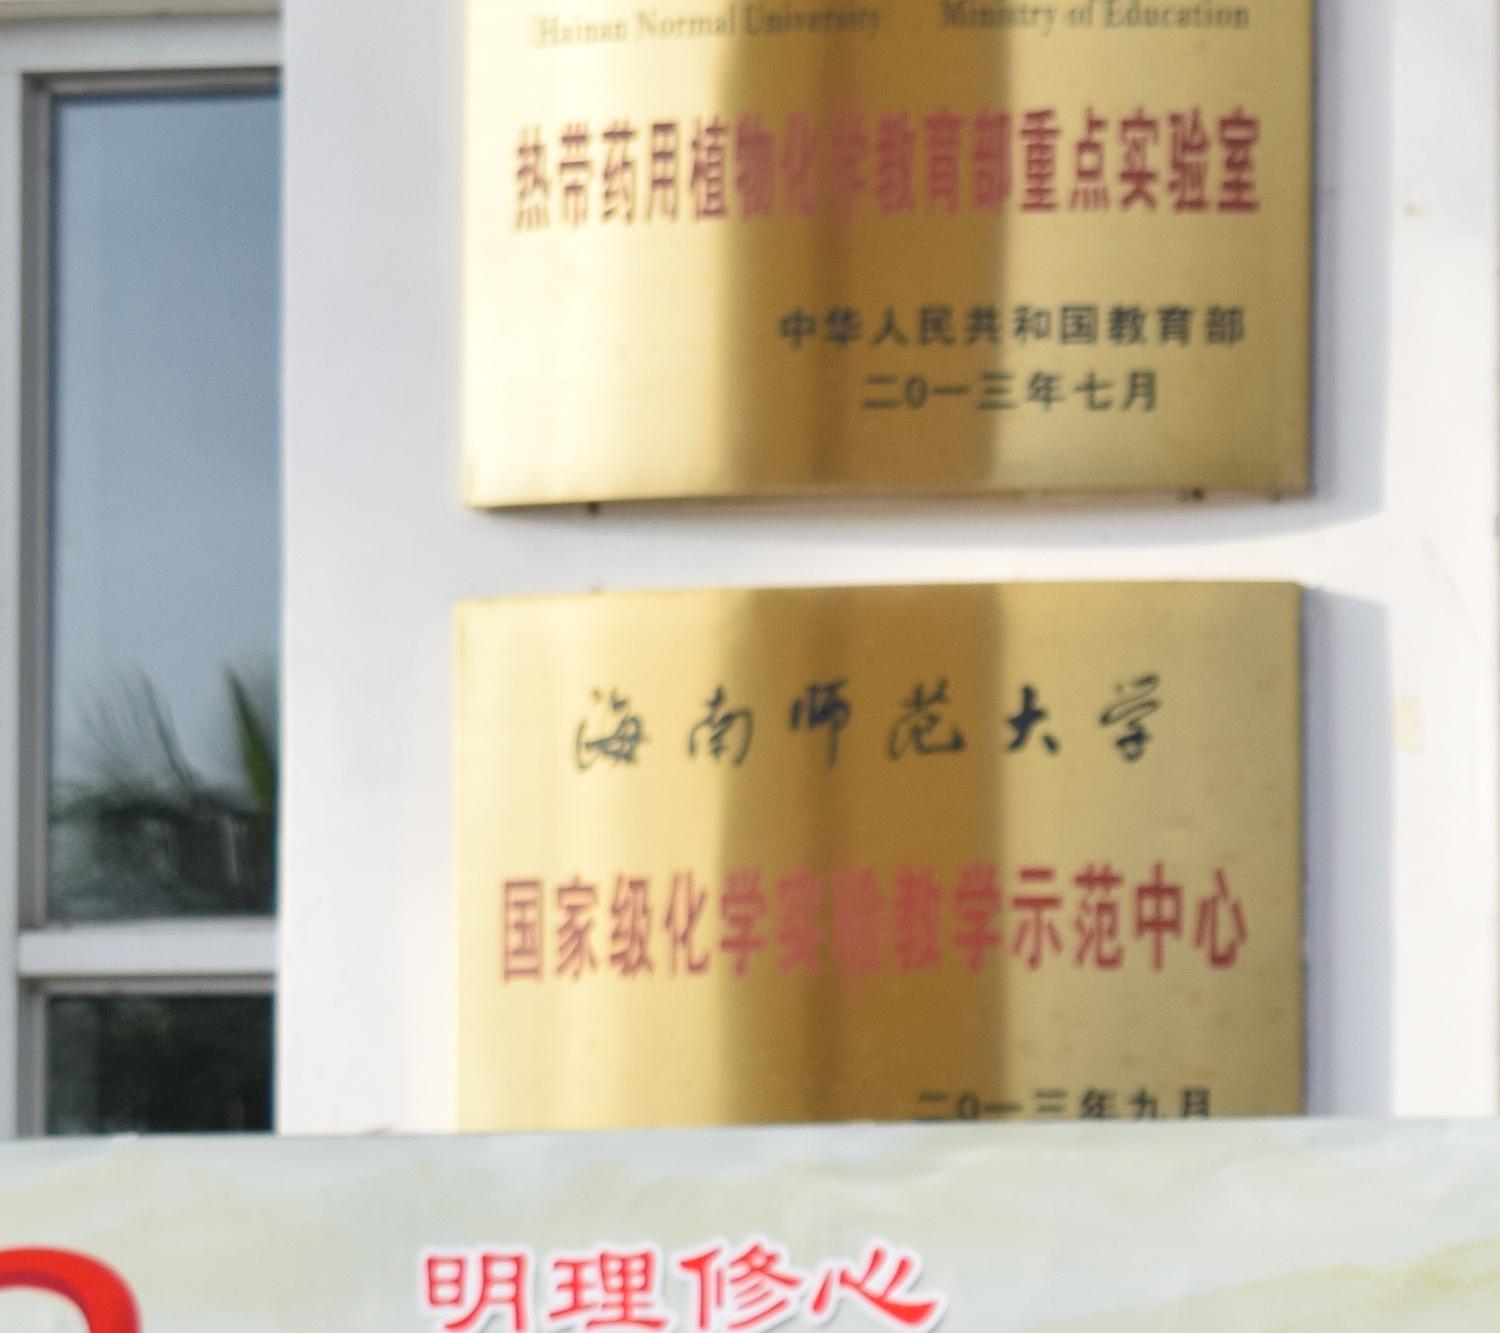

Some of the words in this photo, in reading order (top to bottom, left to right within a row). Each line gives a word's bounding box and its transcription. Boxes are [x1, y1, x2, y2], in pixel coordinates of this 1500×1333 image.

[535, 14, 628, 47] Hainan
[635, 5, 735, 41] Normal
[744, 2, 880, 41] University
[779, 306, 1246, 348] 中华人民共和国教育部
[575, 673, 1166, 770] 海南师范大学
[501, 863, 1248, 984] 国家级化学实验教学示范中心
